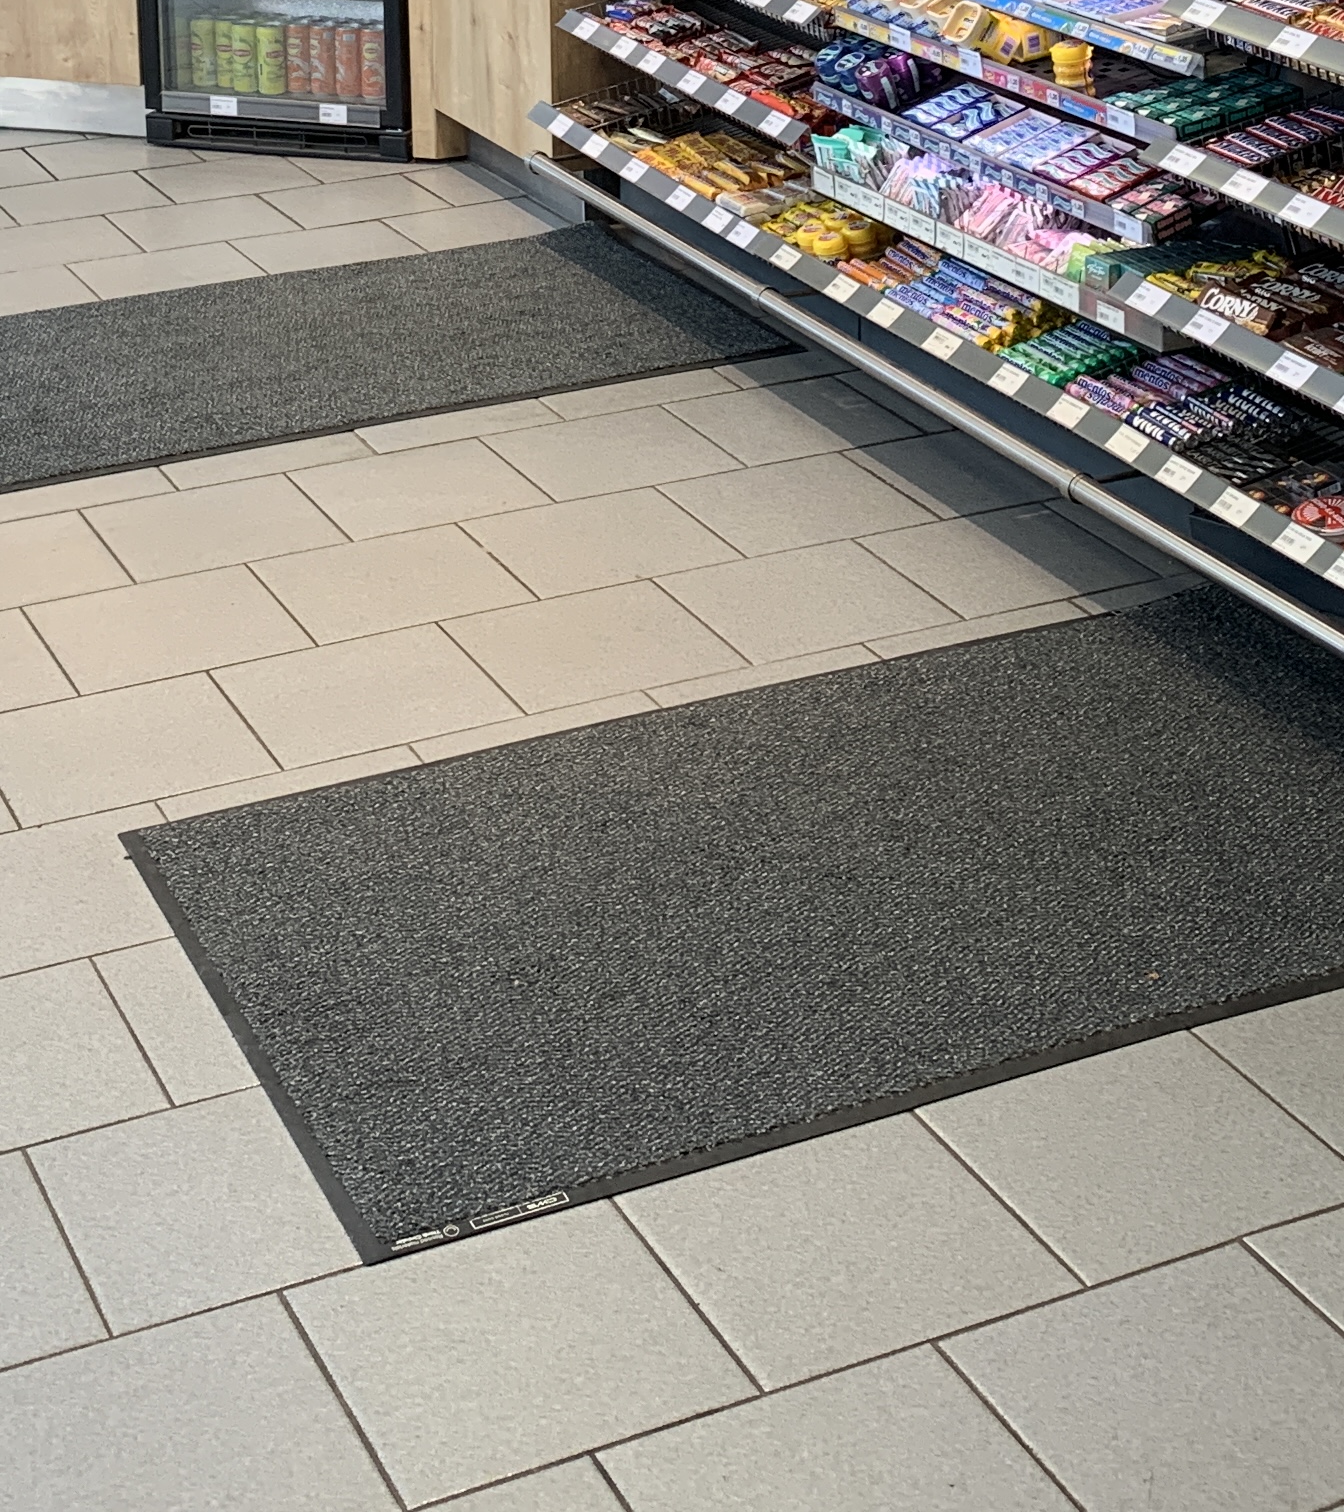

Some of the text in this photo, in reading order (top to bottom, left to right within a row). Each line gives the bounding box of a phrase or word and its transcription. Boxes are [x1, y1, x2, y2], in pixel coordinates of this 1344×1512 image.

[1200, 287, 1258, 320] CORNY
[1134, 368, 1170, 390] mentos
[1132, 417, 1164, 440] VIVIL
